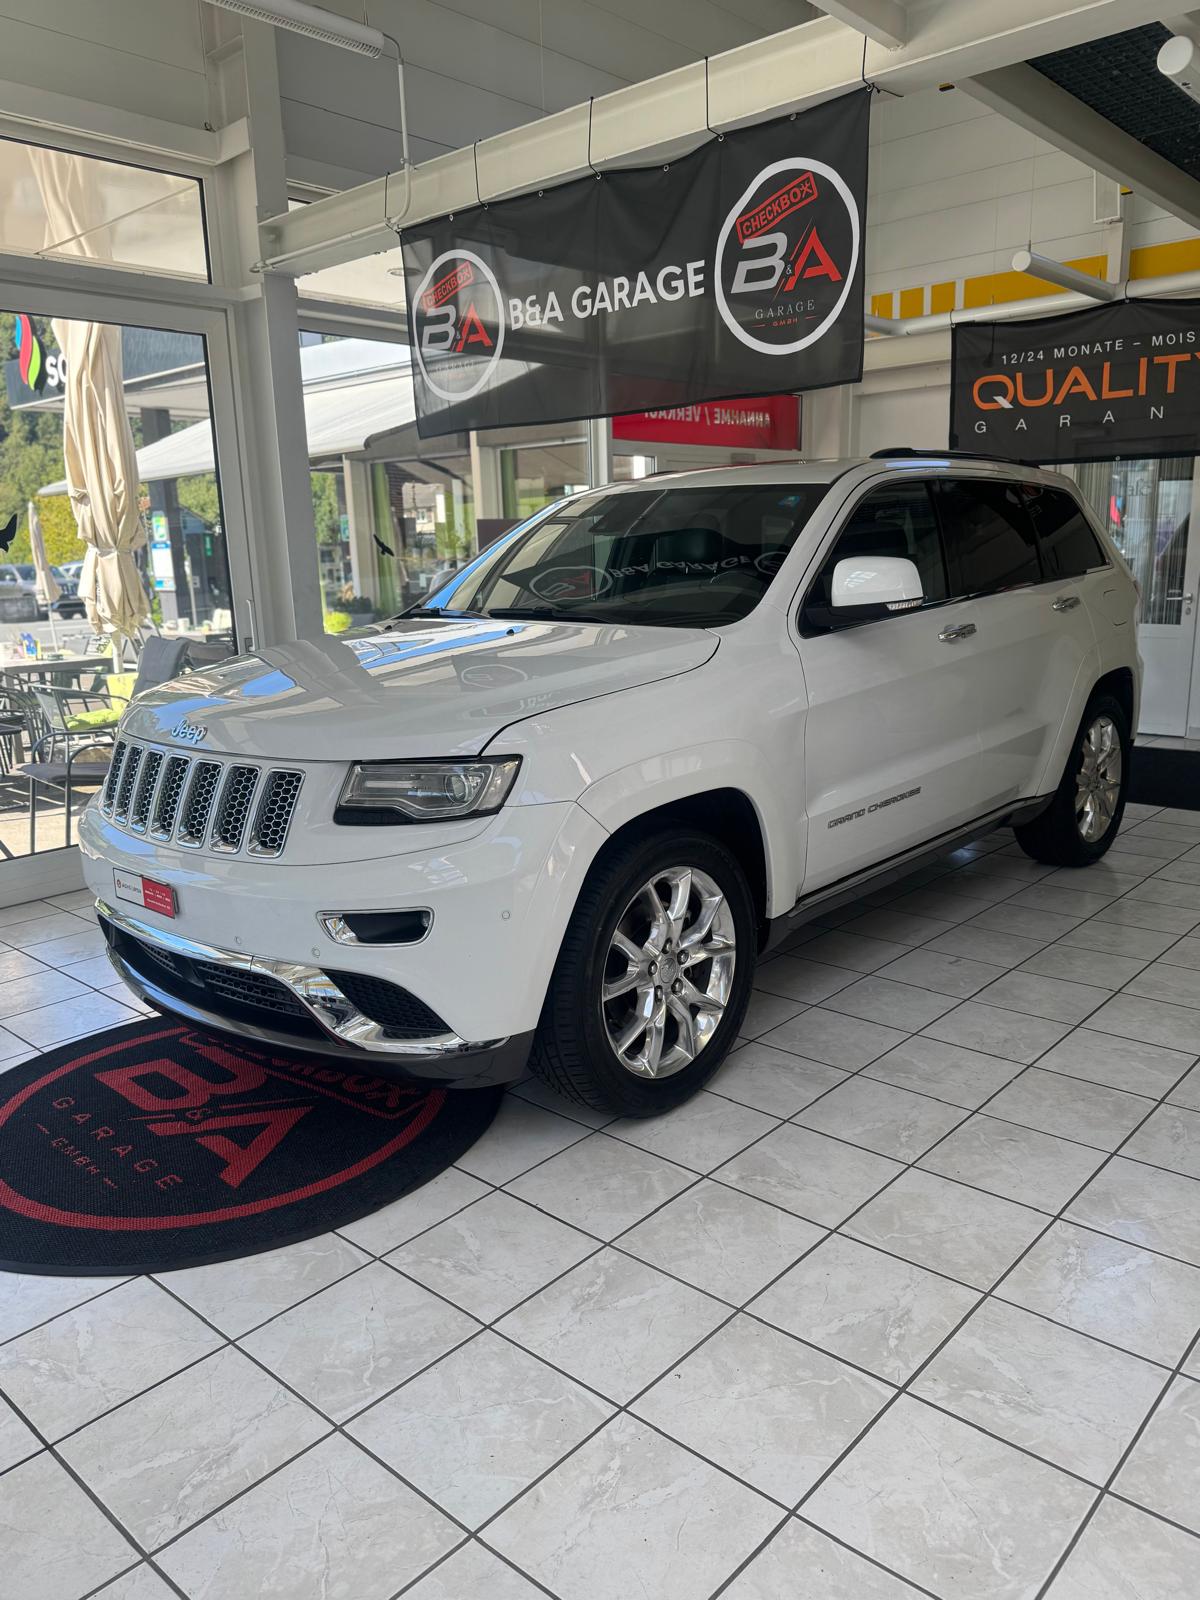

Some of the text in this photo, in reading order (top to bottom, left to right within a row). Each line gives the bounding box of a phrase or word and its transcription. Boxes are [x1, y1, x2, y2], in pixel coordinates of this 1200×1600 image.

[742, 180, 814, 235] CHECKBOX
[426, 266, 472, 307] CHECKBOX
[509, 260, 705, 331] B&A GARAGE
[755, 299, 815, 320] GARAGE
[1001, 350, 1045, 365] 12/24
[1053, 339, 1124, 359] MONATE
[1151, 330, 1196, 347] MOIS
[972, 351, 1200, 411] QUALIT
[171, 719, 208, 745] Jeep
[827, 786, 922, 829] GRAND CHEROKEE
[52, 1096, 184, 1191] GARAGE
